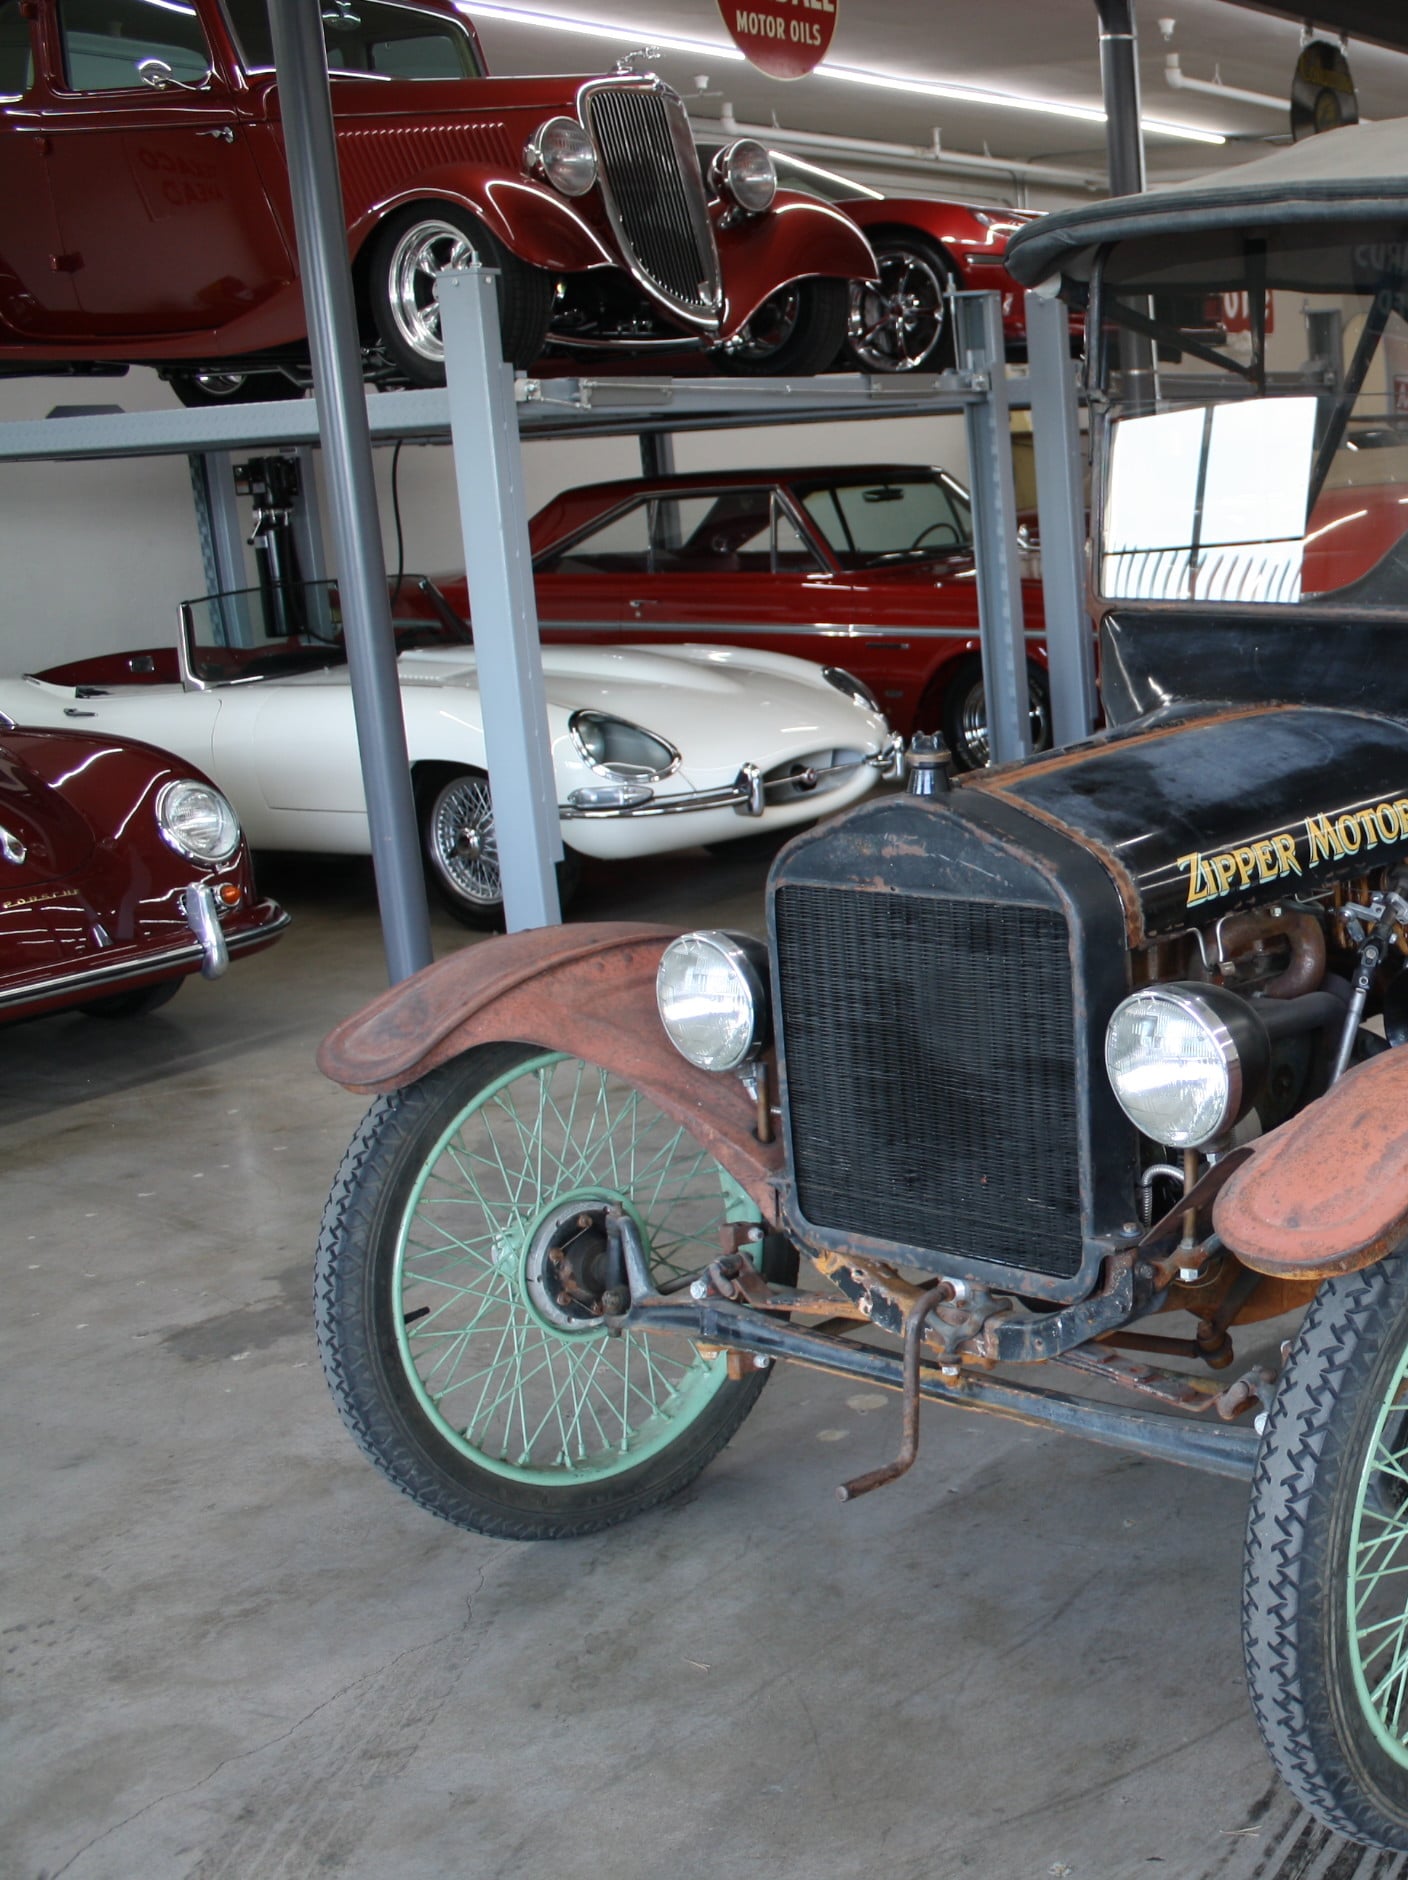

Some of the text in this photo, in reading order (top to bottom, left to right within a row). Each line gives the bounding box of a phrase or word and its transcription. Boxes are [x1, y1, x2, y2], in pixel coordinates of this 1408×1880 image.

[736, 10, 822, 46] MOTOR OILS
[1177, 833, 1303, 908] ZIPPER
